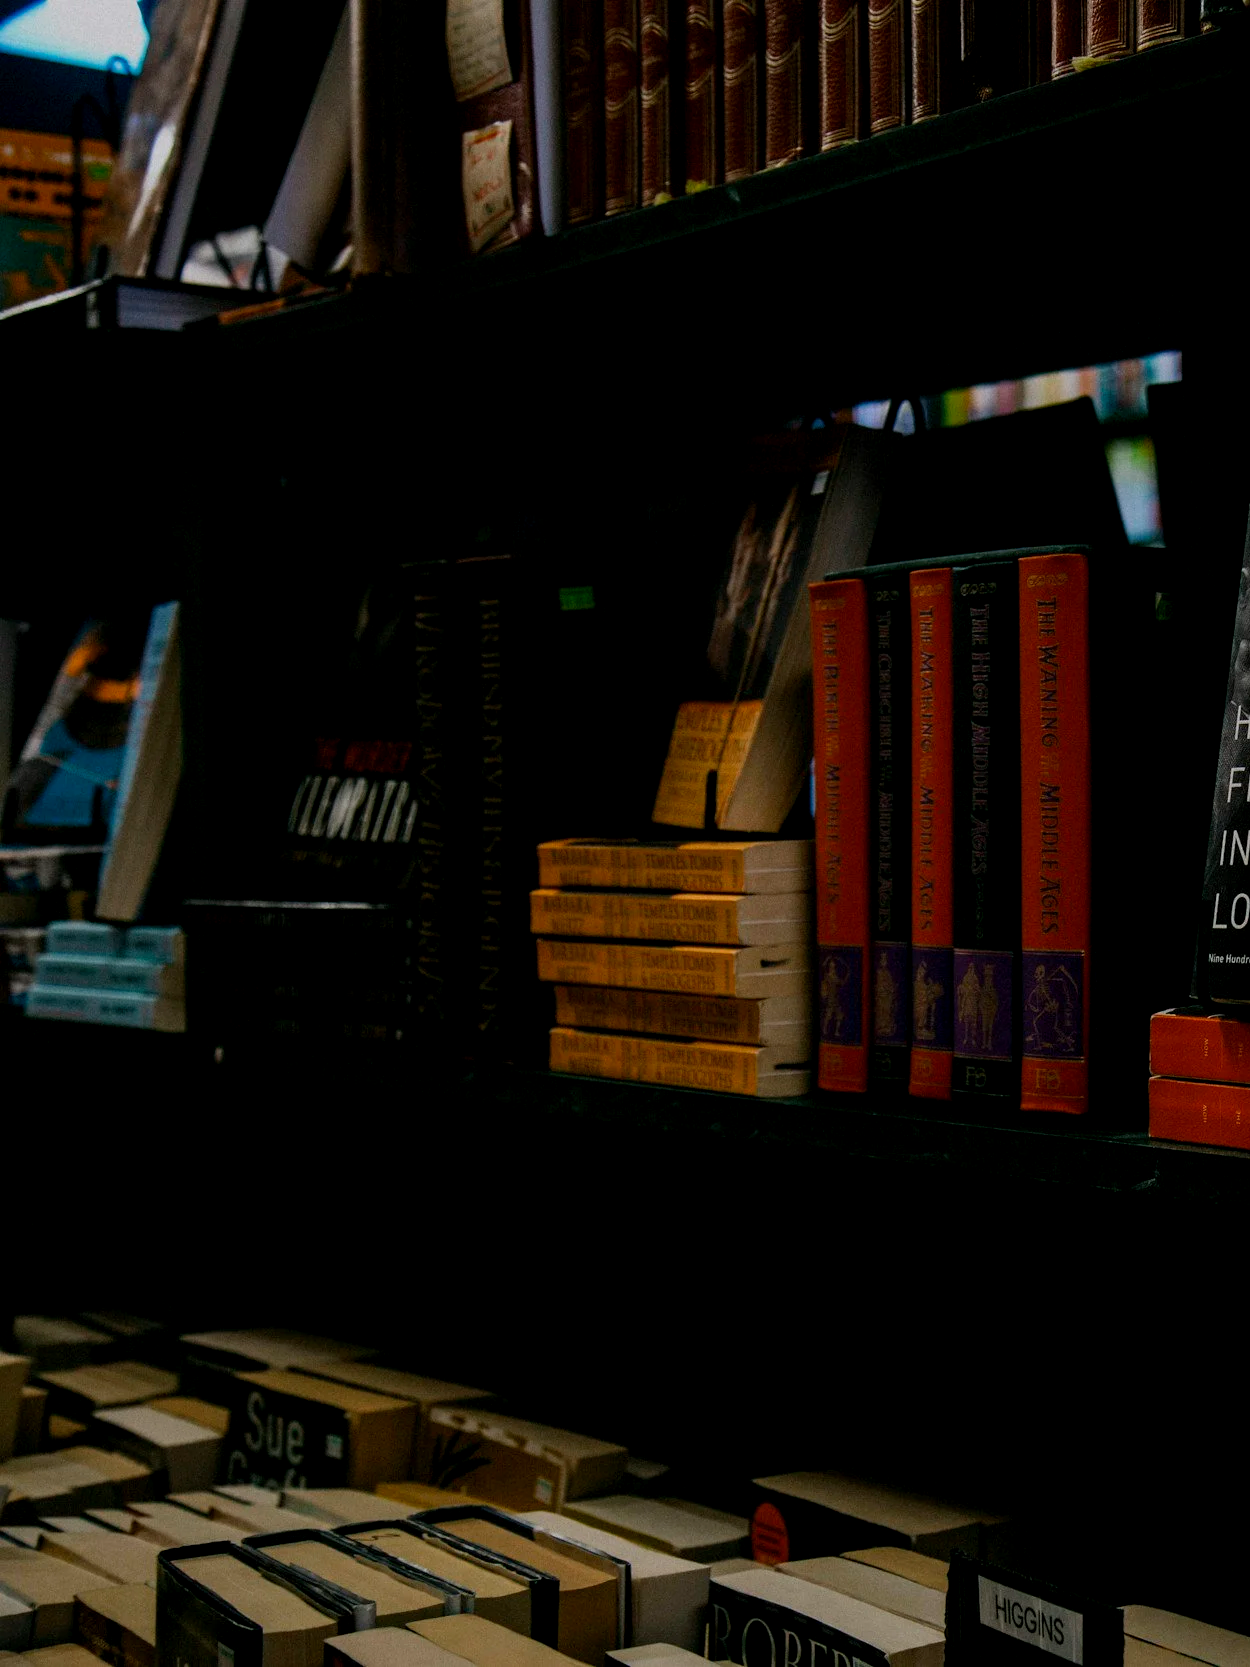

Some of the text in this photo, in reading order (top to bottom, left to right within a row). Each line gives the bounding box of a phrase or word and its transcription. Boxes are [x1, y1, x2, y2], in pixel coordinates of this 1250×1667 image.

[920, 650, 936, 754] MAKING
[970, 603, 992, 876] THE HIGH MIDDLE AGES
[1036, 598, 1062, 936] THE WANING MIDDLE AGES
[1208, 953, 1224, 964] Nine
[243, 1390, 305, 1466] Sue
[994, 1594, 1065, 1646] HIGGINS
